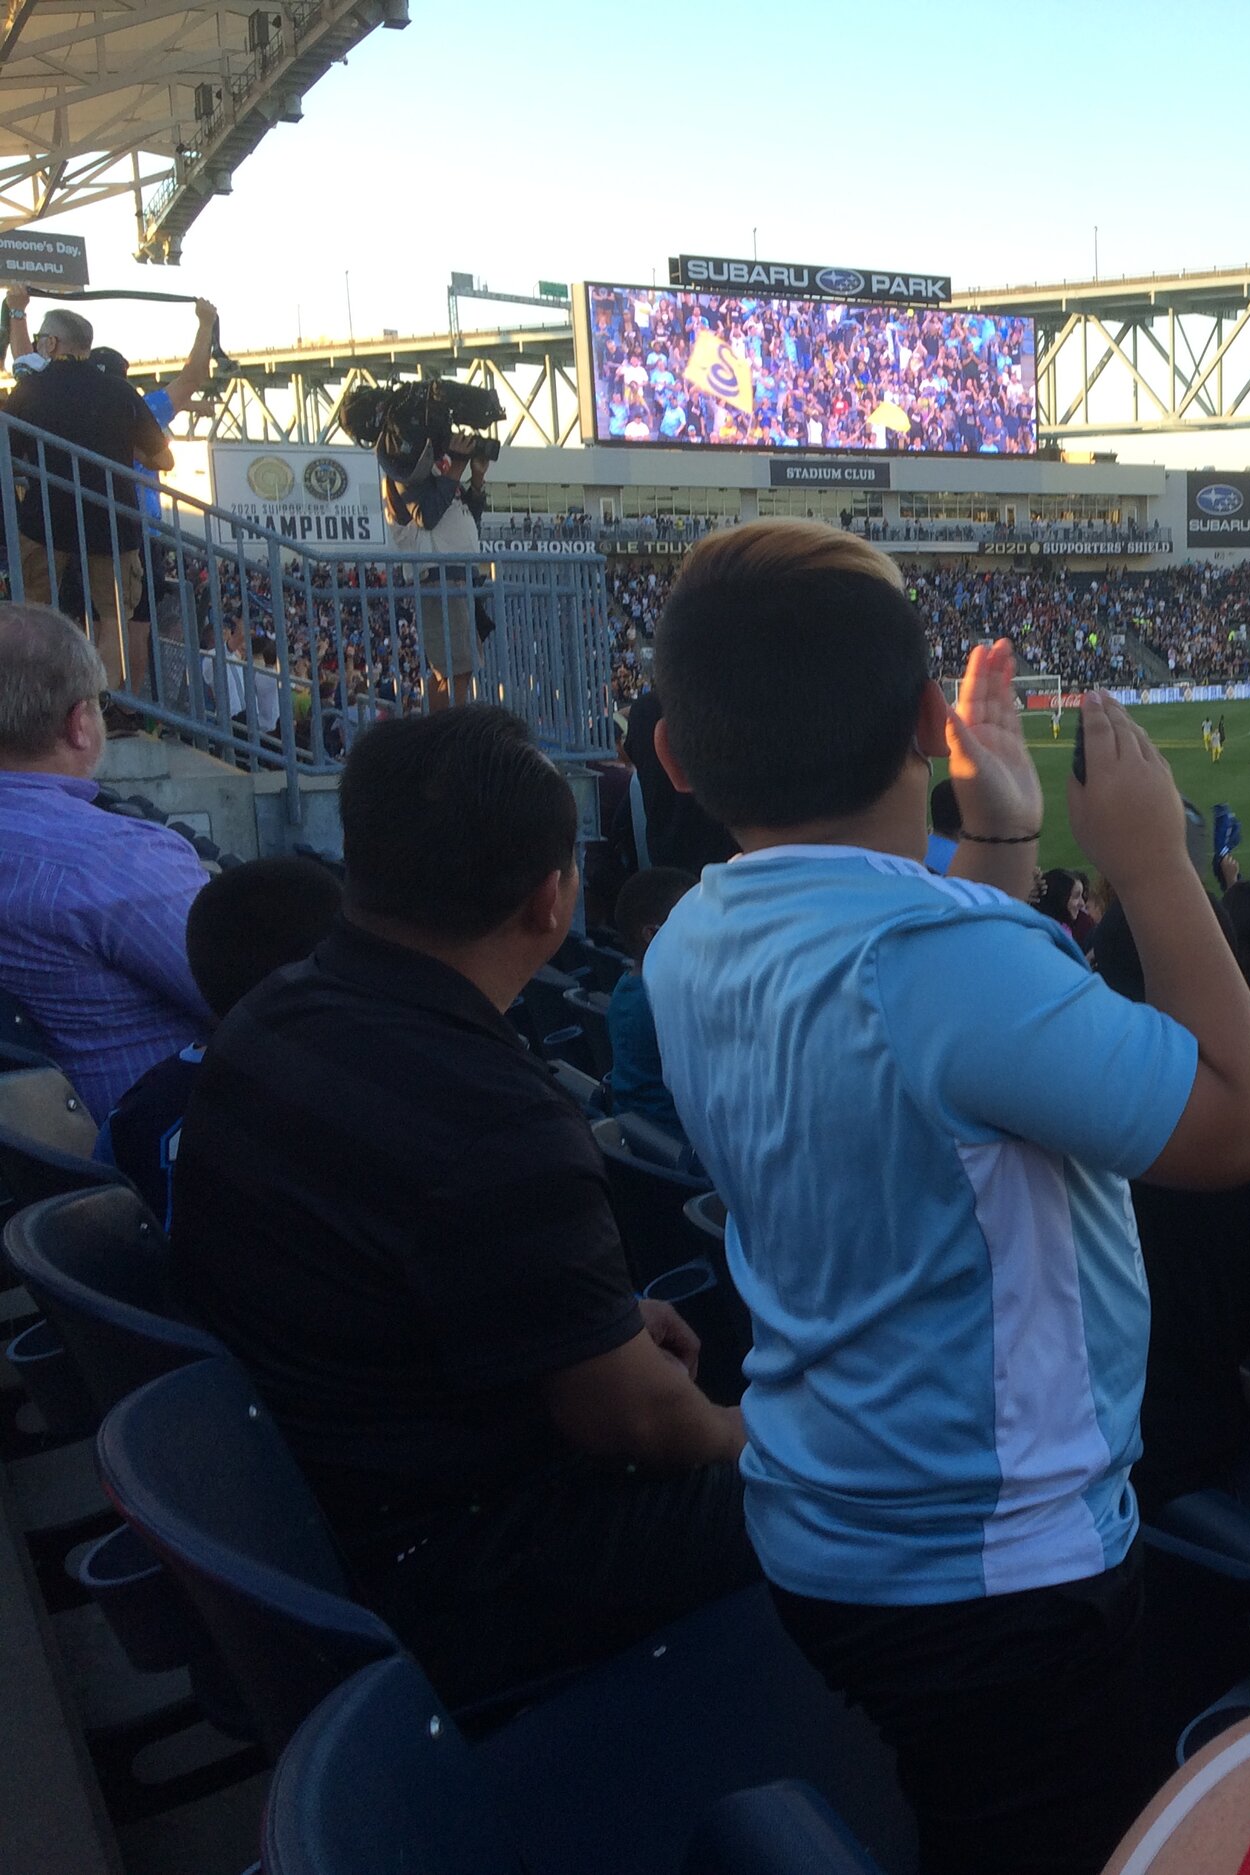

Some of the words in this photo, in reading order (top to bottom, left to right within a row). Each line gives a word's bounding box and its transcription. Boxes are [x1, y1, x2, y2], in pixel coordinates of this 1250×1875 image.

[0, 239, 53, 253] omeone's
[56, 242, 81, 257] Day.
[6, 260, 63, 274] SUBARU
[687, 260, 809, 288] SUBARU
[871, 275, 946, 298] PARK
[786, 467, 841, 480] STADIUM
[844, 468, 875, 480] CLUB
[1189, 519, 1250, 532] SUBARU
[537, 540, 596, 553] HONOR
[616, 542, 639, 554] LE
[984, 543, 1027, 554] 2020
[1127, 541, 1170, 553] SHIELD
